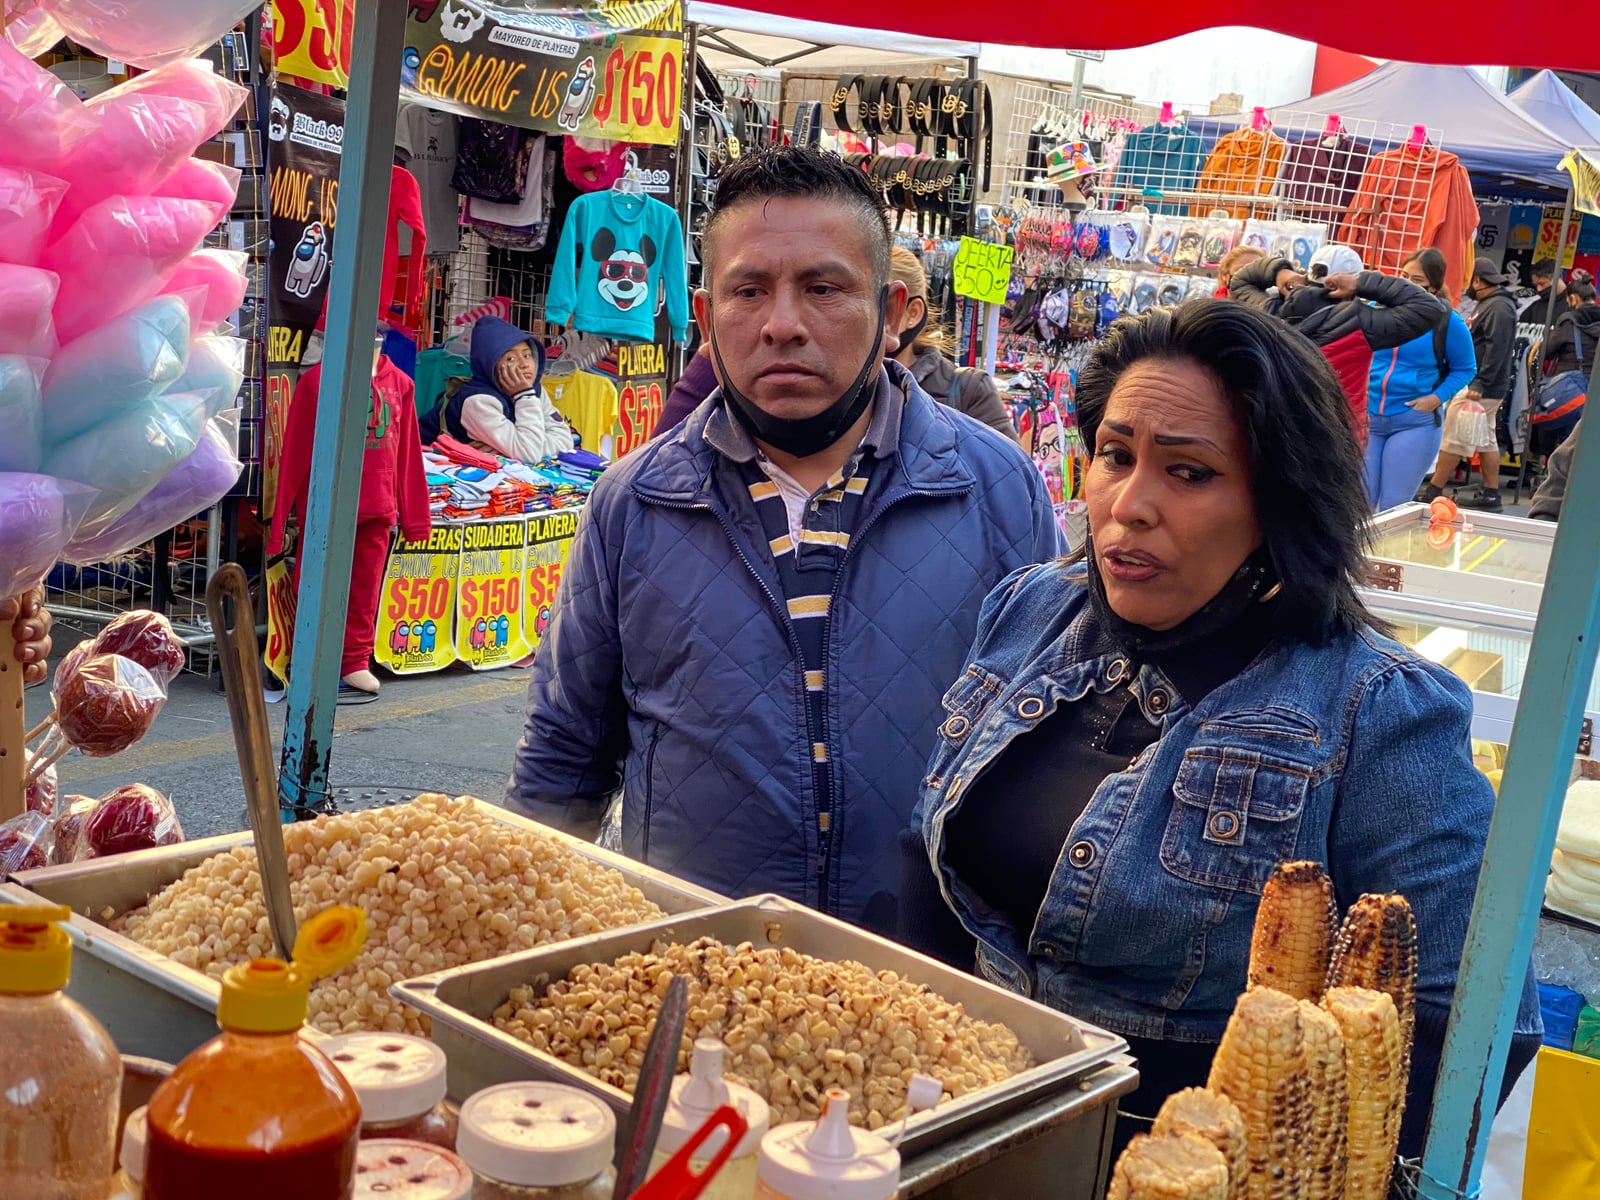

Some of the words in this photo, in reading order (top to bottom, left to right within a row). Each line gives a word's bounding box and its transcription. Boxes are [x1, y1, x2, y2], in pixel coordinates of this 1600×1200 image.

[532, 39, 541, 48] DE
[542, 41, 577, 55] PLAYERAS
[418, 44, 526, 111] AMONG
[530, 67, 568, 119] US
[592, 42, 678, 128] $150
[293, 112, 326, 138] Black
[327, 124, 344, 143] 99
[653, 170, 669, 184] 99
[269, 165, 314, 222] MONG
[320, 176, 338, 228] US
[958, 239, 1012, 269] OFERTA
[955, 264, 993, 296] $50
[618, 343, 665, 377] PLAYERA
[616, 380, 663, 459] $50
[464, 523, 524, 549] SUDADERA
[387, 577, 450, 623] $50
[460, 576, 520, 620] $150
